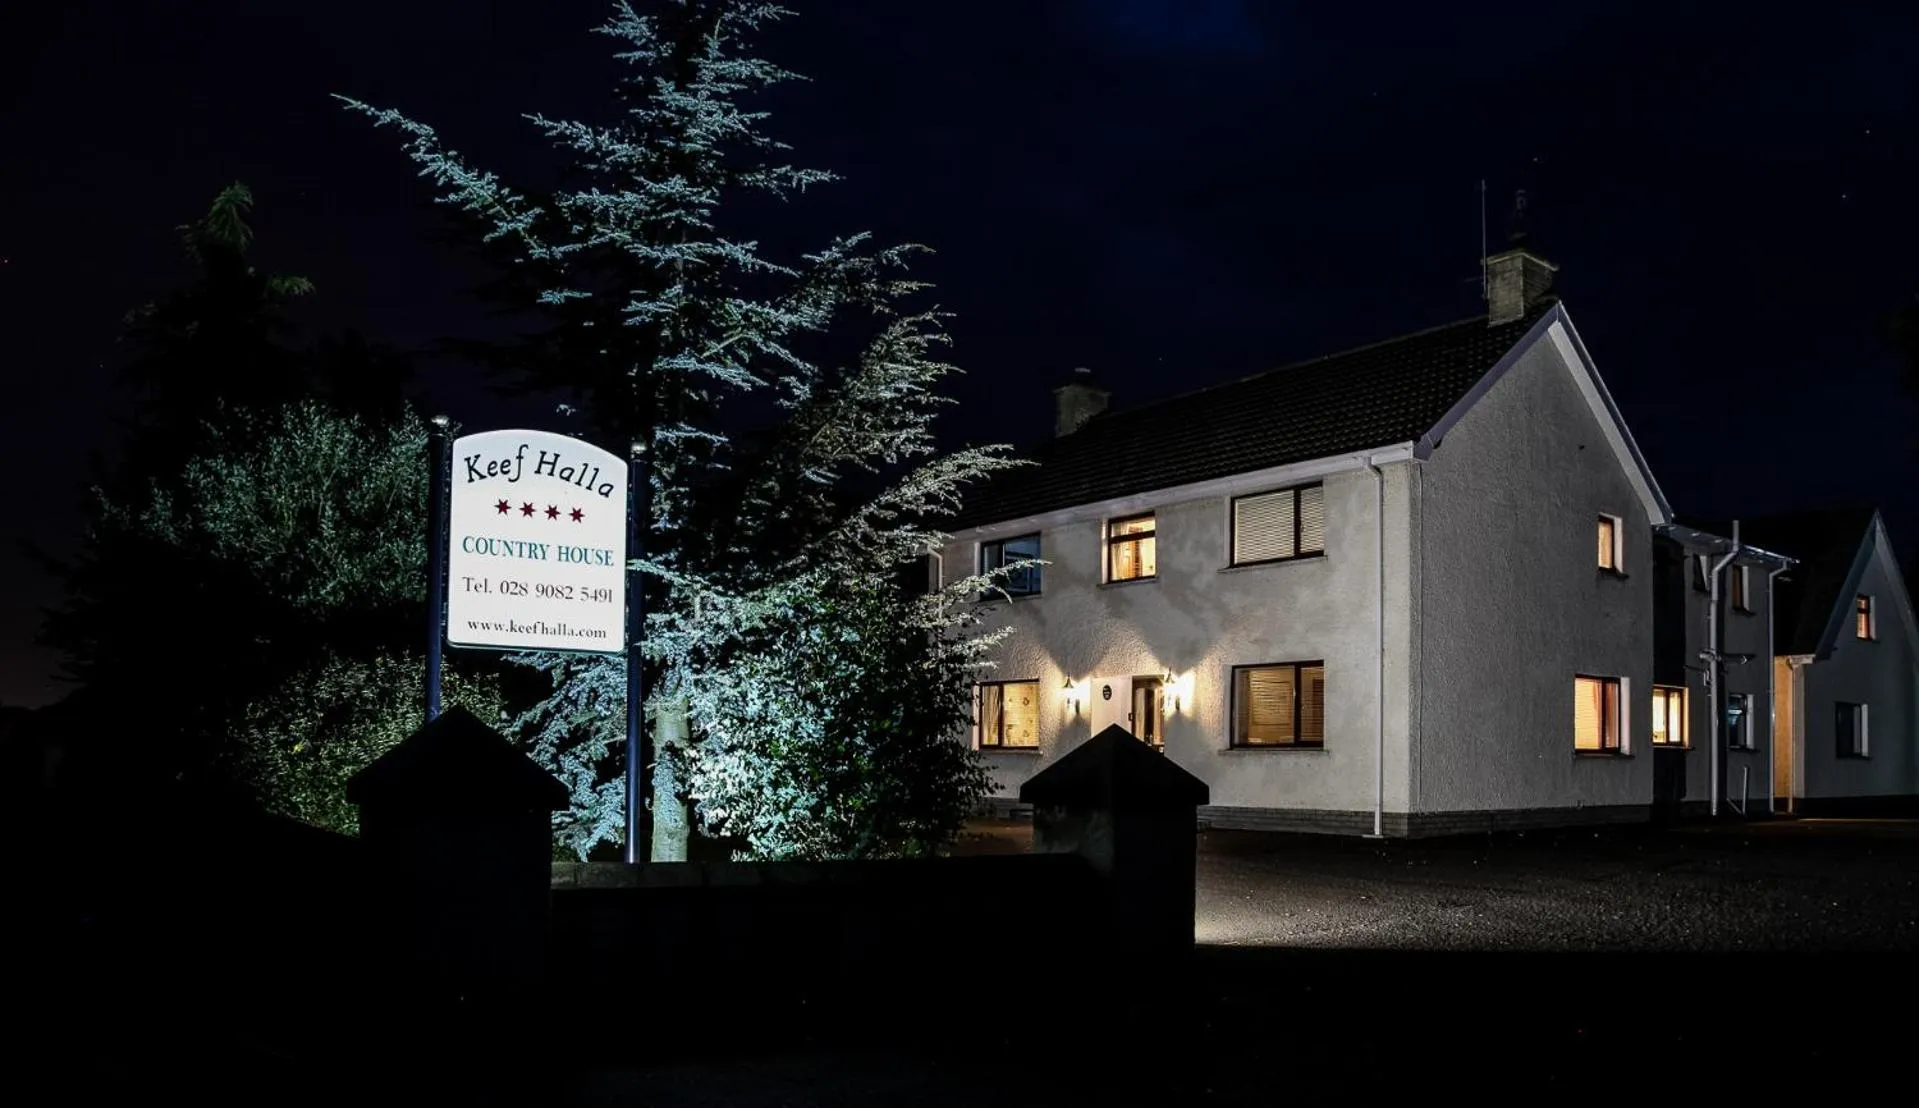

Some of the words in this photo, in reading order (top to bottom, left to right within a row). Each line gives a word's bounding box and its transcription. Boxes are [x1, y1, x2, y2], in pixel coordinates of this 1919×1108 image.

[464, 444, 529, 483] Keef
[534, 450, 615, 498] Halla
[462, 535, 550, 561] COUNTRY
[557, 545, 614, 566] HOUSE
[462, 576, 492, 594] Tel.
[500, 580, 528, 596] 028
[535, 583, 573, 600] 9082
[580, 586, 613, 603] 5491
[467, 619, 607, 639] www.keefhalla.com
